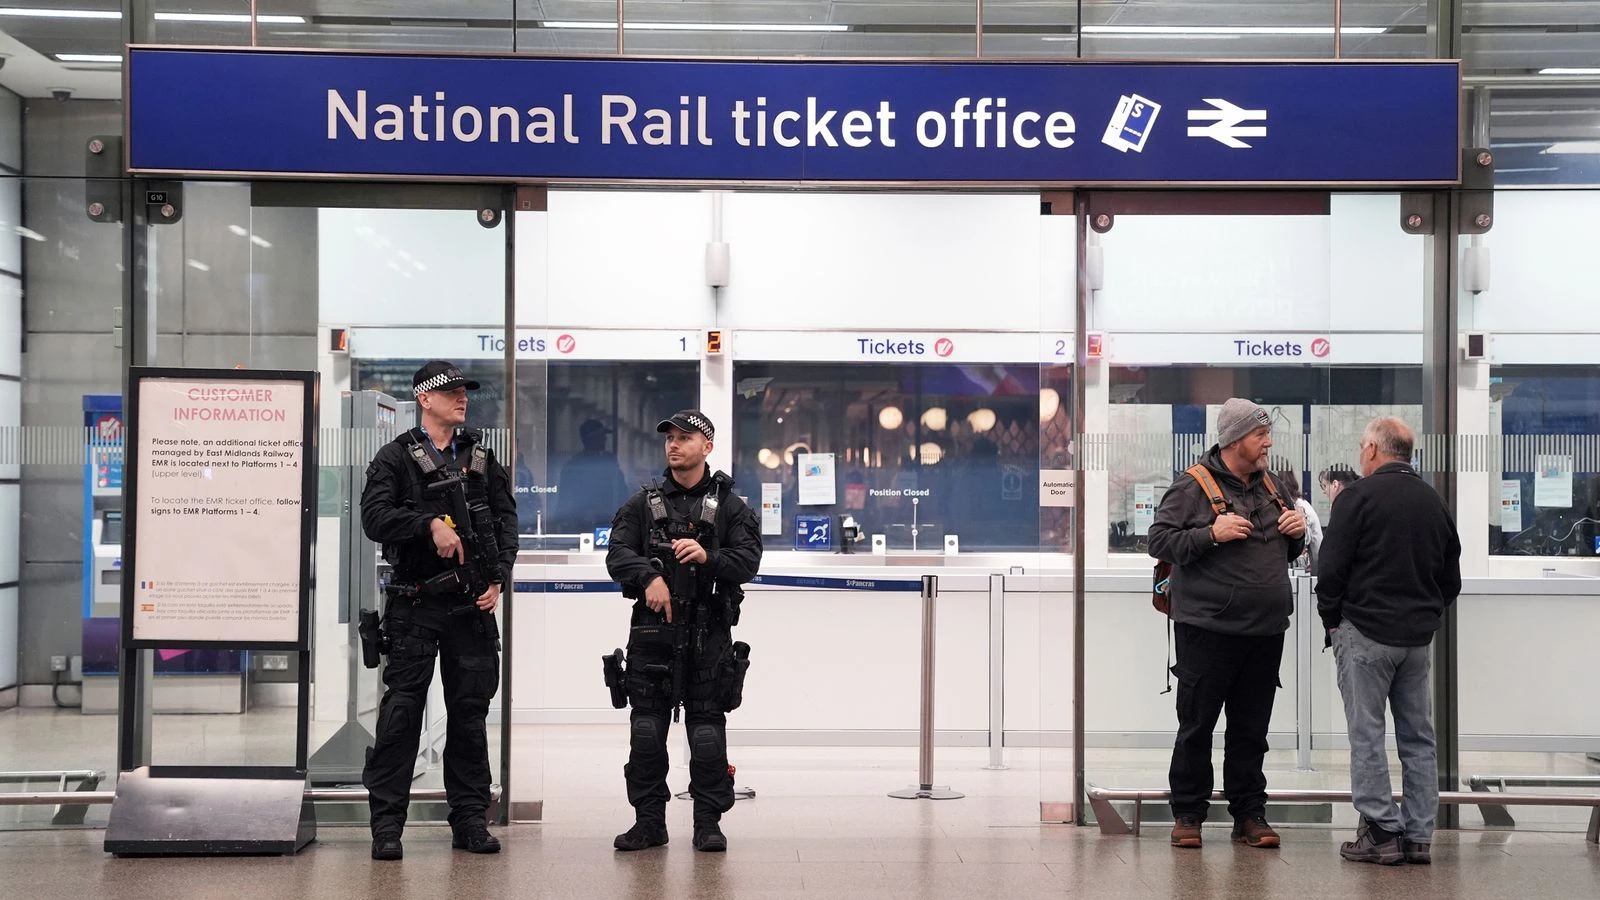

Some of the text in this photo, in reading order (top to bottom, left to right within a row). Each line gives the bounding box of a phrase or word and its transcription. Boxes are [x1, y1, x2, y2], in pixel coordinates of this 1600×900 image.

[327, 89, 1076, 149] National Rail ticket office
[477, 335, 546, 352] Ticets
[679, 338, 687, 352] 1
[708, 332, 721, 352] 2
[857, 338, 925, 355] Tickets
[1055, 340, 1066, 355] 2
[1087, 336, 1101, 355] 3
[1234, 339, 1302, 357] Tickets
[188, 387, 272, 402] CUSTOMER
[174, 407, 285, 422] INFORMATION
[152, 438, 179, 446] Please
[216, 439, 257, 447] additional
[152, 450, 192, 458] managed
[194, 449, 204, 458] by
[225, 449, 261, 458] Midlands
[263, 450, 294, 459] Railway
[170, 459, 177, 467] is
[179, 460, 210, 468] located
[152, 470, 179, 479] (upper
[530, 485, 558, 493] Closed
[869, 488, 930, 496] Position Closed
[151, 497, 161, 505] To
[162, 497, 190, 505] locate
[191, 497, 204, 505] the
[225, 497, 247, 505] ticket
[276, 498, 301, 506] follow
[151, 508, 172, 516] signs
[202, 508, 238, 516] Platforms
